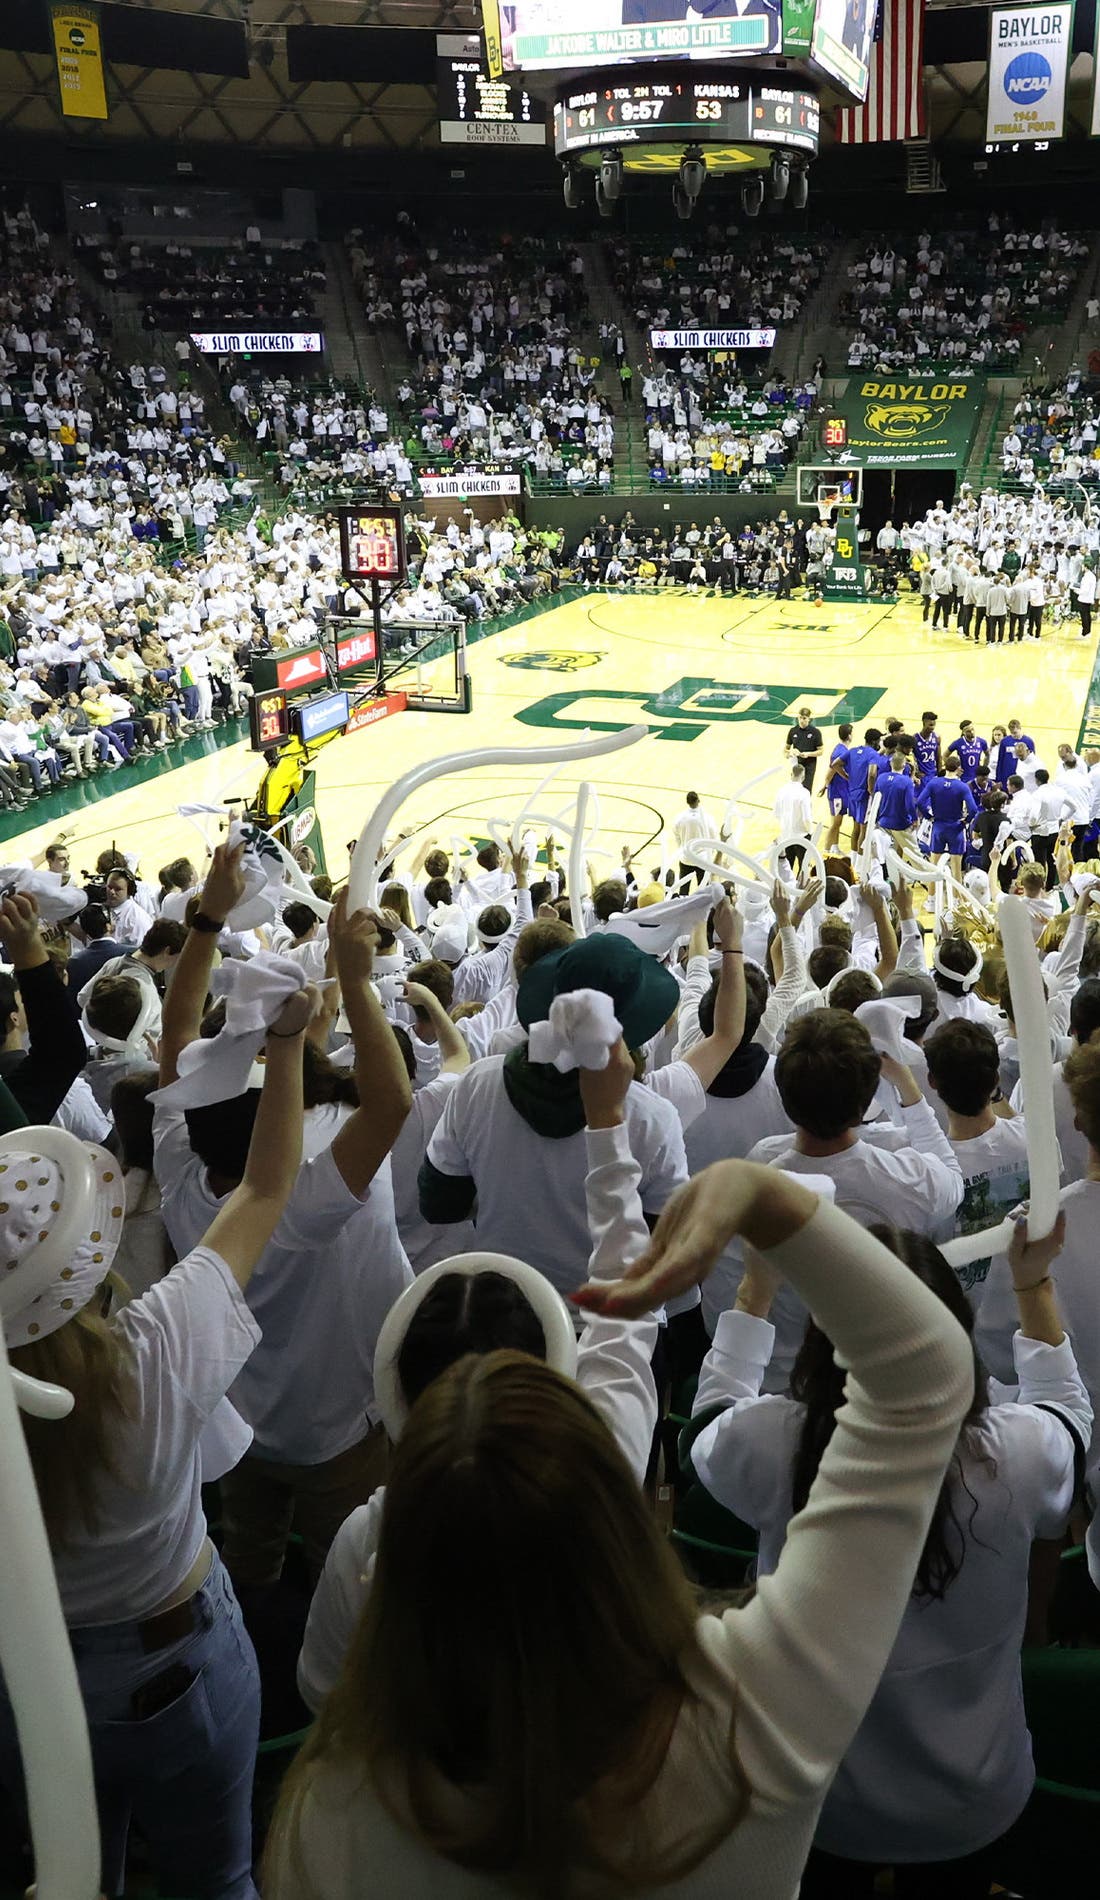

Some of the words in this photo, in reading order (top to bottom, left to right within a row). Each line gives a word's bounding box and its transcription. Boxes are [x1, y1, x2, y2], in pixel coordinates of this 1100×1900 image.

[999, 15, 1062, 38] BAYLOR
[595, 32, 642, 52] WALTER
[645, 31, 655, 47] &
[657, 27, 689, 47] MIRO
[691, 24, 732, 44] LITTLE
[1020, 38, 1062, 47] BASKETBALL
[1008, 76, 1050, 92] NCAA
[569, 92, 598, 109] BAYLOR
[605, 89, 612, 100] 3
[613, 88, 631, 99] TOL
[652, 85, 673, 96] TOL
[693, 84, 740, 98] KANSAS
[761, 88, 794, 104] BAYLOR
[578, 107, 596, 128] 61
[621, 100, 664, 121] 9:57
[695, 100, 722, 119] 53
[755, 107, 764, 119] B
[775, 105, 792, 125] 61
[466, 123, 518, 136] CEN-TEX
[994, 123, 1025, 134] FINAL
[1027, 121, 1056, 132] FOUR
[212, 335, 240, 351] SLIM
[244, 335, 294, 351] CHICKENS
[673, 332, 699, 346] SLIM
[703, 332, 751, 346] CHICKENS
[860, 382, 968, 400] BAYLOR
[826, 428, 843, 444] 30
[848, 438, 948, 447] aylorBears.com
[484, 465, 500, 473] KAN
[436, 481, 458, 494] SLIM
[461, 480, 501, 493] CHICKENS
[837, 538, 853, 558] BU
[261, 716, 278, 739] 30
[922, 752, 935, 763] 24
[968, 755, 976, 767] 0
